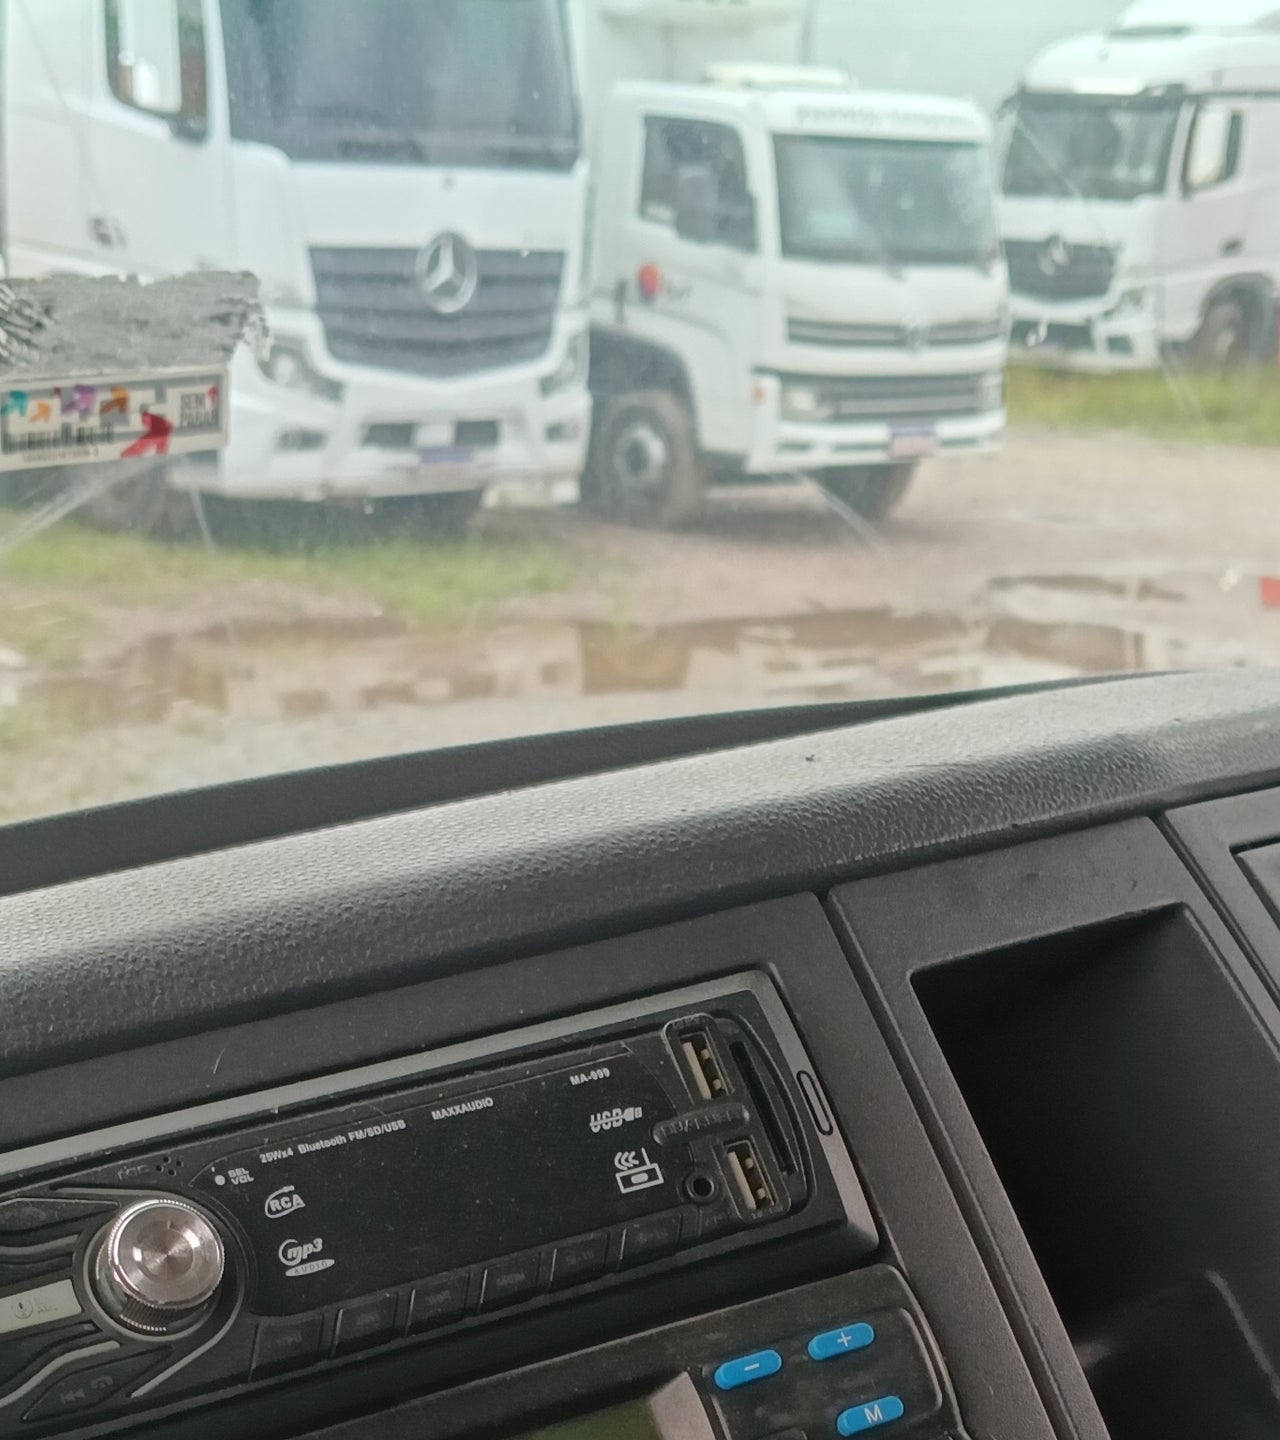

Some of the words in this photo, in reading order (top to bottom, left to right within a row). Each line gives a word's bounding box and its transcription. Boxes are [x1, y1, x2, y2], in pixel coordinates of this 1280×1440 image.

[431, 1096, 494, 1121] MAXXAUDIO
[259, 1147, 294, 1164] 25Wx4
[297, 1134, 347, 1154] Bluetooth
[348, 1119, 407, 1142] FM/SD/USB
[268, 1191, 306, 1214] RCA
[283, 1237, 324, 1265] mp3
[863, 1403, 883, 1424] M
